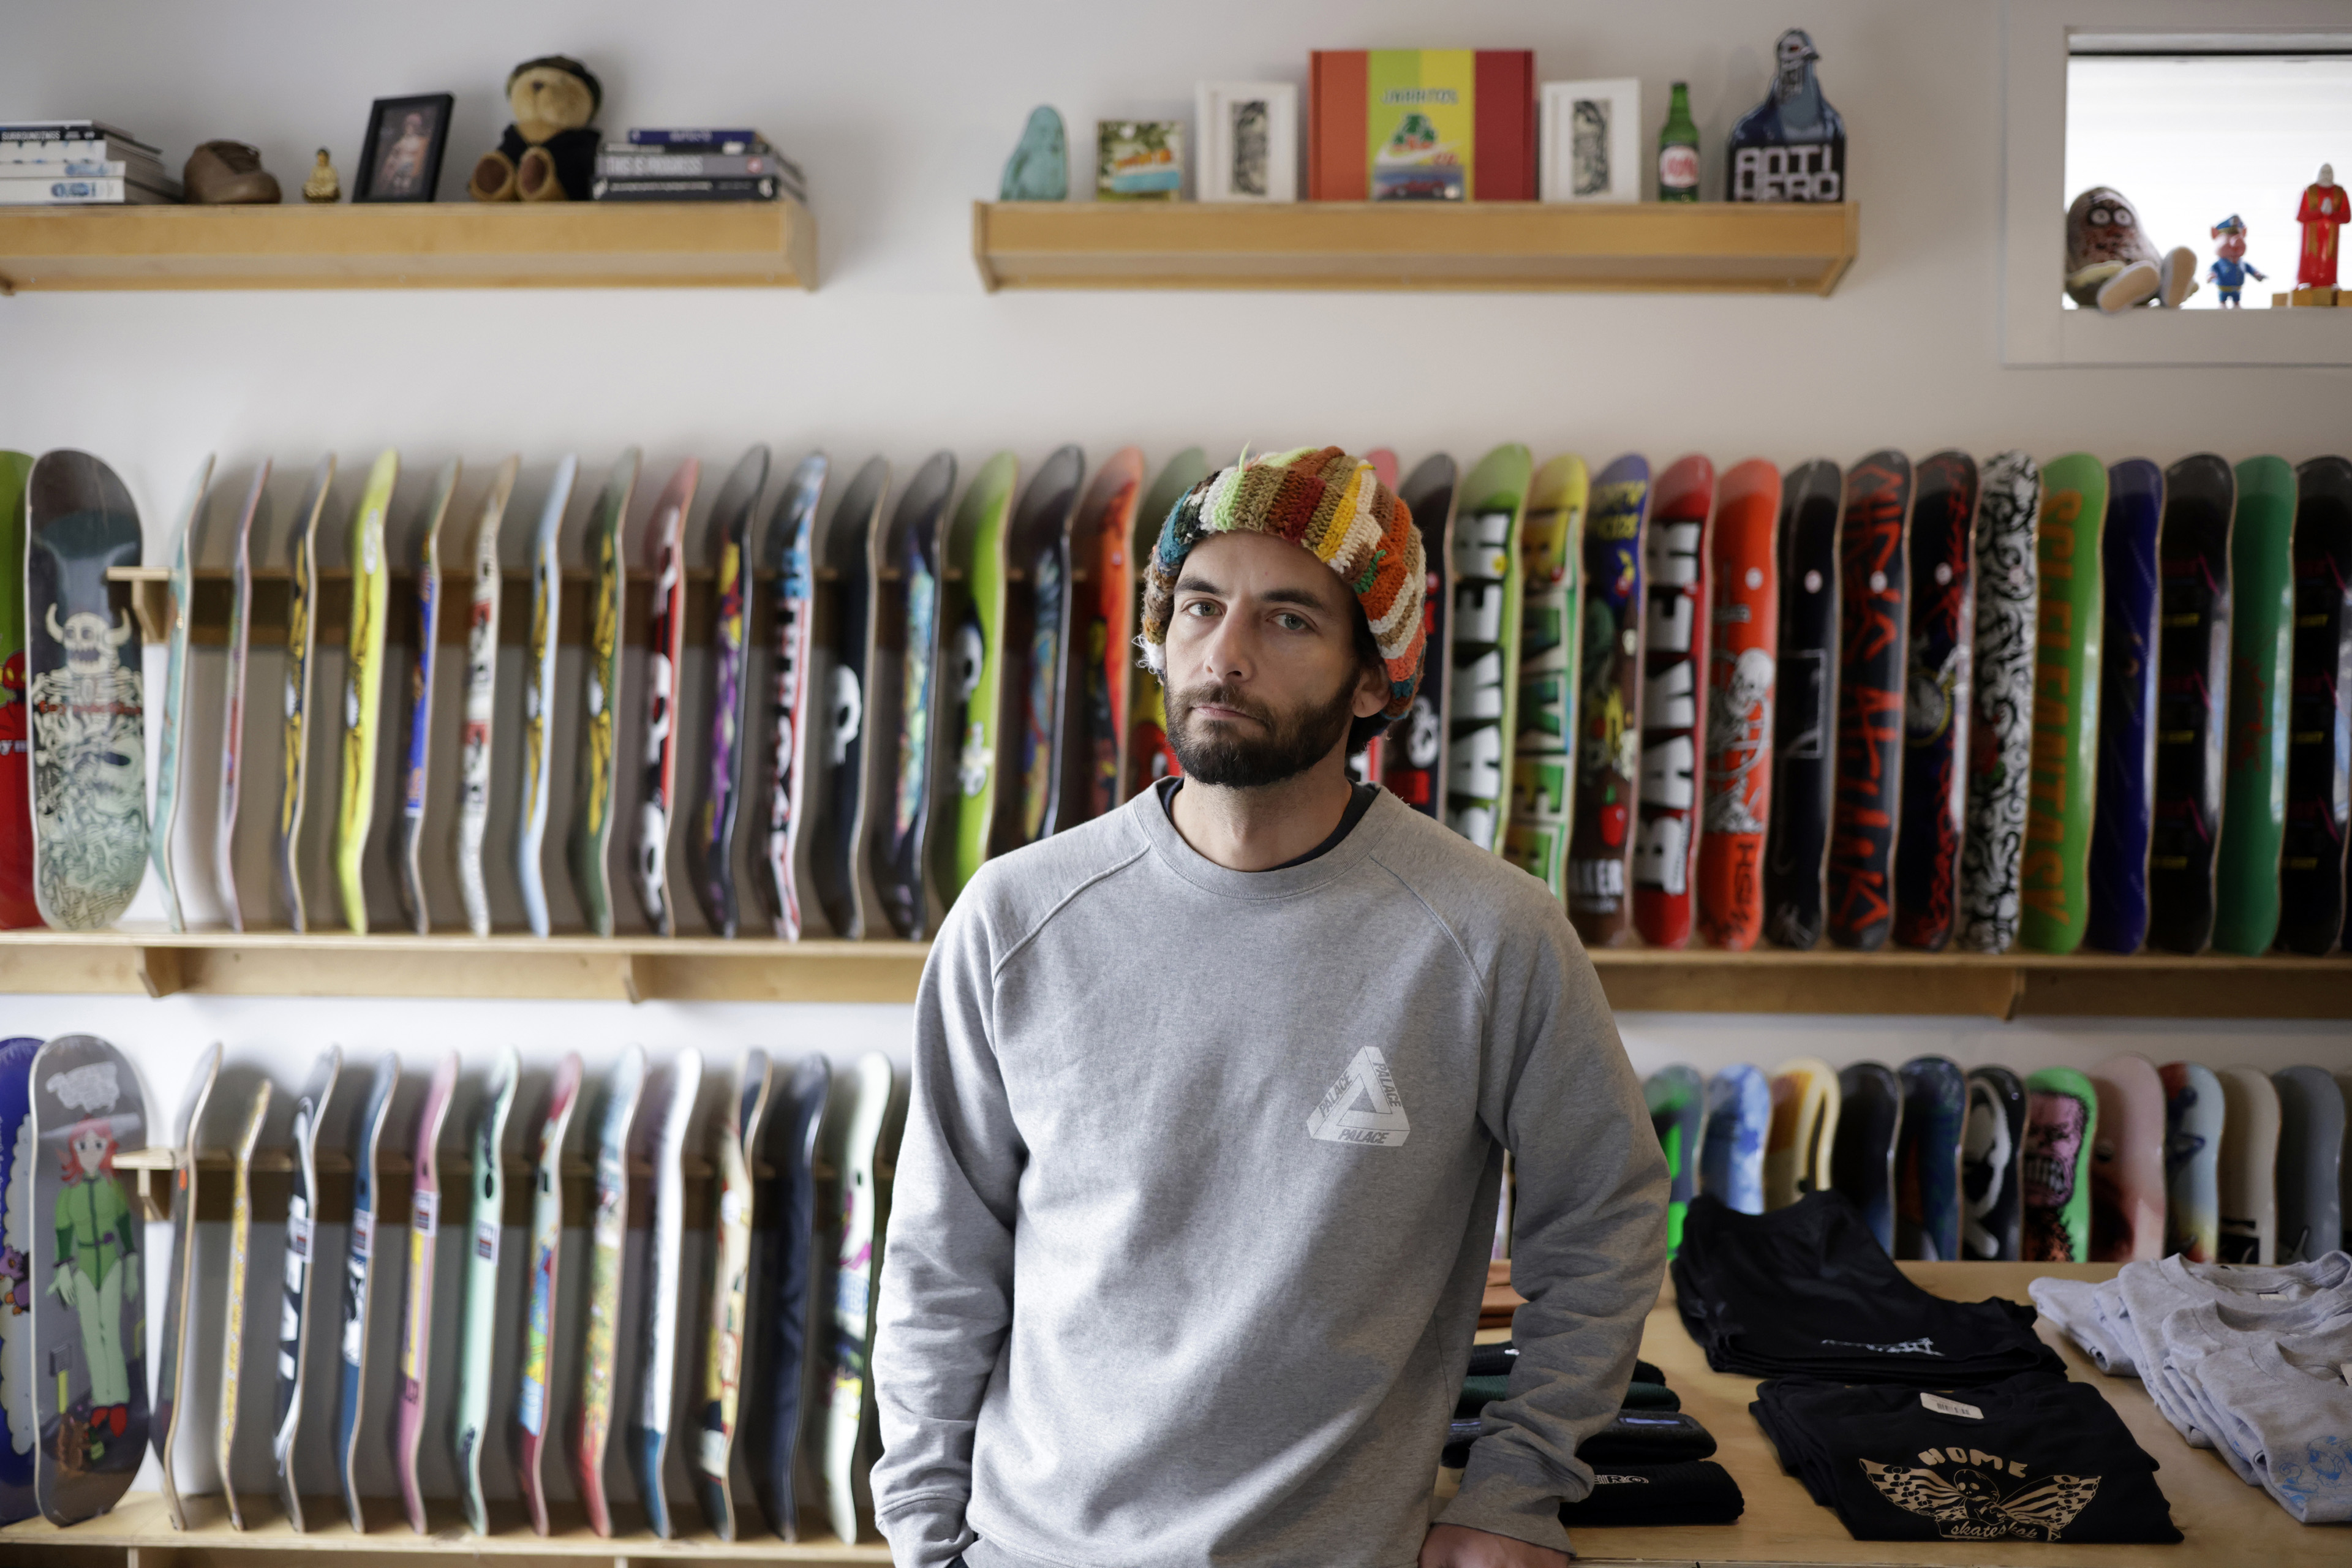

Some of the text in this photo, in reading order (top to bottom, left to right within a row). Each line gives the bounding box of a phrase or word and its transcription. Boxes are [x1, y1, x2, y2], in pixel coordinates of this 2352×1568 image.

[1318, 1070, 1353, 1118] PALACE
[1372, 1061, 1401, 1107] PALACE
[1337, 1128, 1390, 1144] PALACE
[1918, 1447, 2028, 1479] HOME
